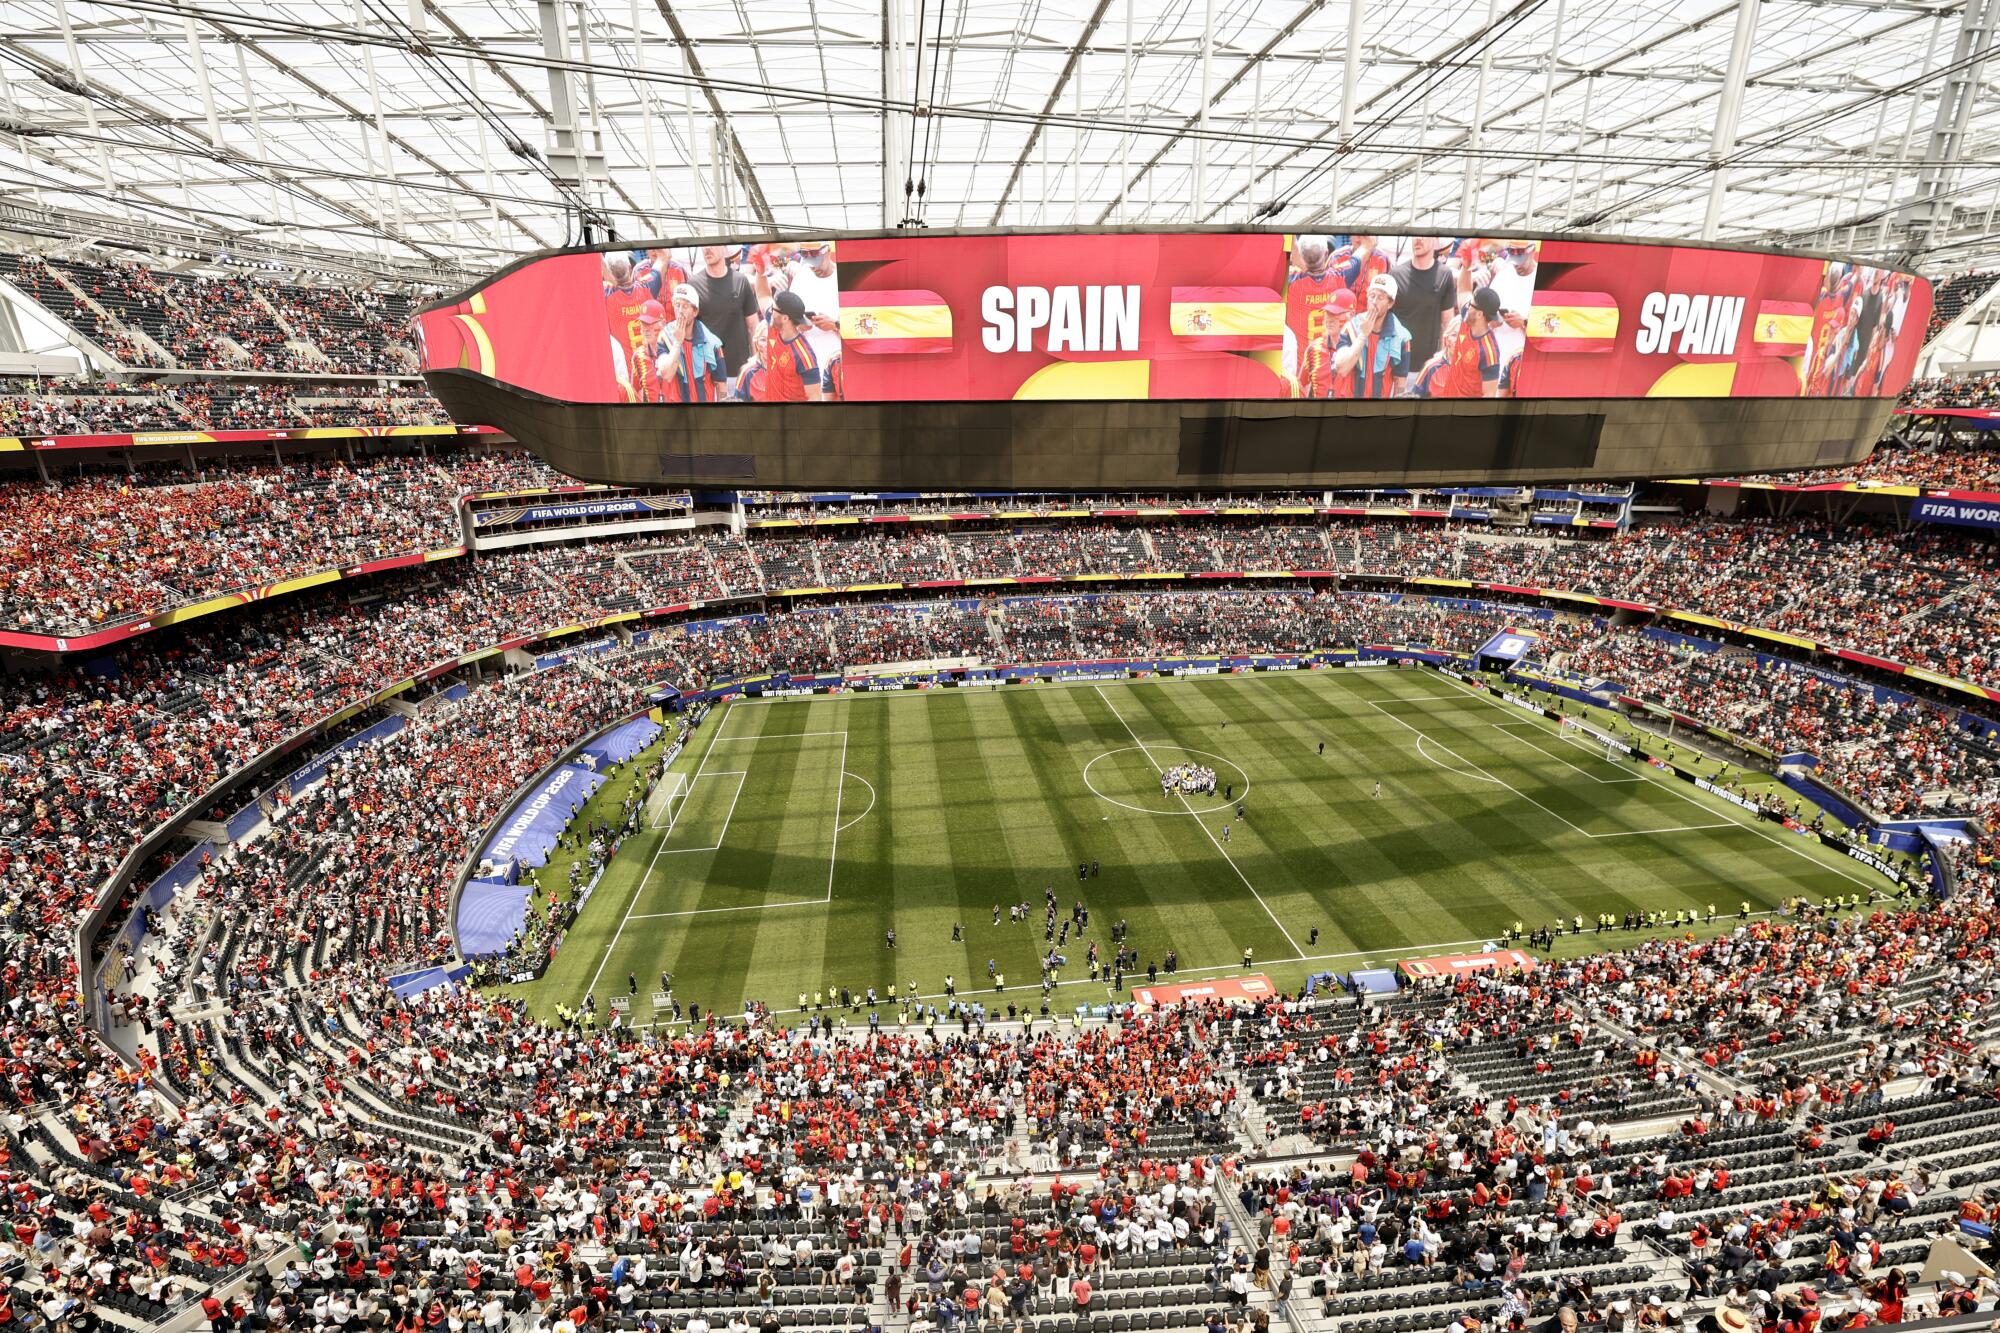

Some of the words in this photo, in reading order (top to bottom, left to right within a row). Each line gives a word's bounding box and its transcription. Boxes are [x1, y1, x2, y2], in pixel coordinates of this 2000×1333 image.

[981, 285, 1141, 353] SPAIN
[1635, 291, 1745, 355] SPAIN
[532, 508, 553, 518] FIFA
[554, 506, 587, 516] WORLD
[588, 504, 606, 514] CUP
[607, 502, 636, 512] 2026
[1921, 504, 1956, 518] FIFA
[1960, 507, 2000, 522] WOR
[294, 767, 311, 780] LOS
[1694, 777, 1712, 791] VISIT
[491, 836, 518, 856] FIFA
[508, 808, 540, 838] WORLD
[531, 793, 552, 810] CUP
[545, 769, 574, 795] 2026
[1848, 848, 1874, 866] FIFA
[1874, 860, 1900, 882] STORE
[510, 971, 534, 984] ORE
